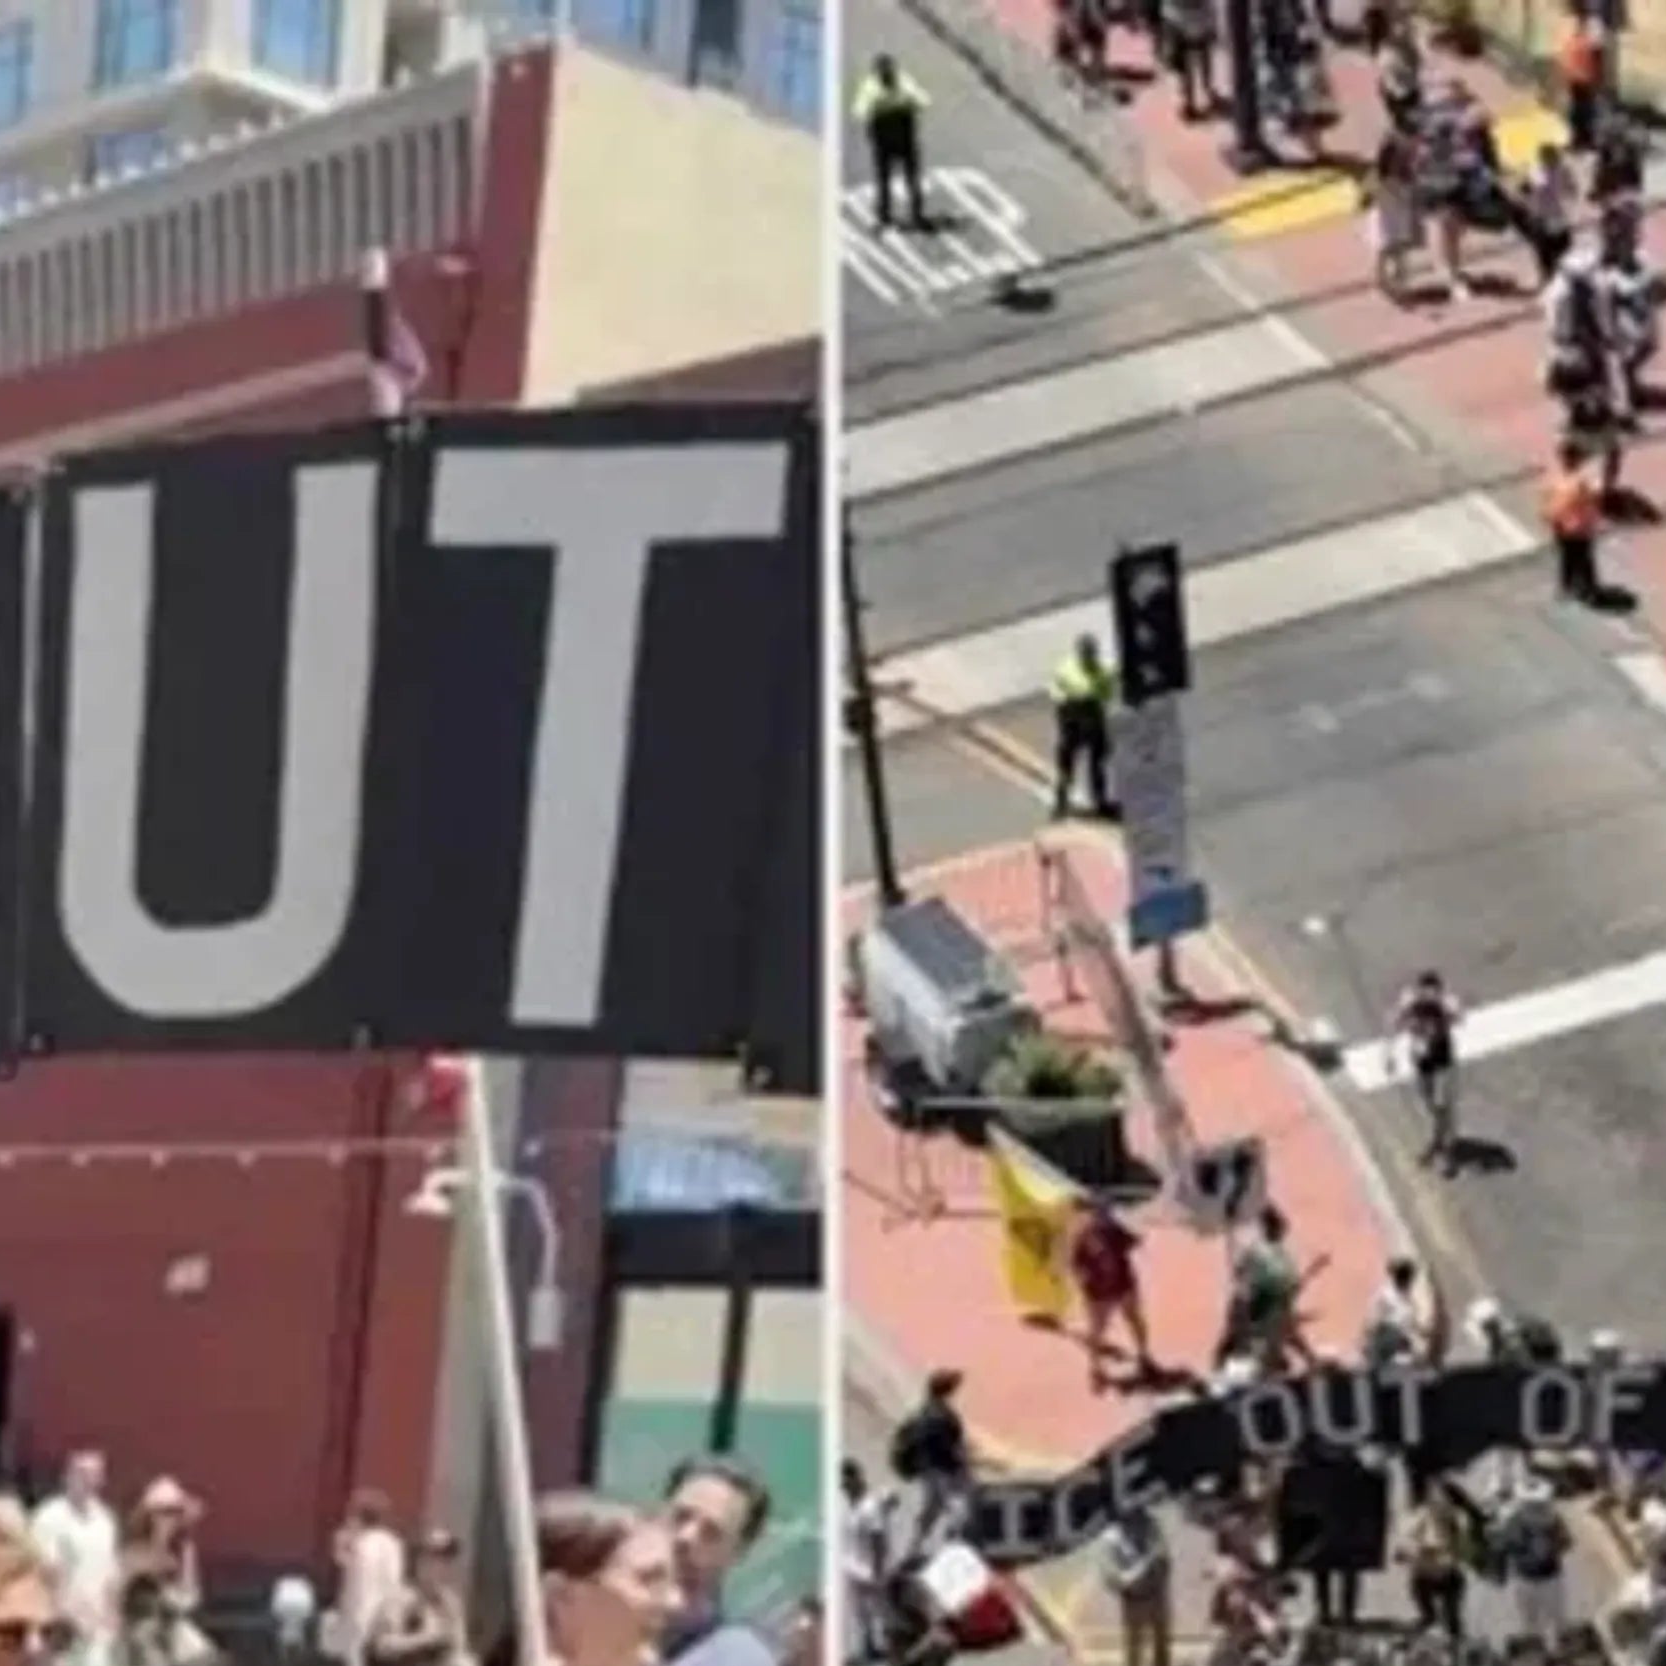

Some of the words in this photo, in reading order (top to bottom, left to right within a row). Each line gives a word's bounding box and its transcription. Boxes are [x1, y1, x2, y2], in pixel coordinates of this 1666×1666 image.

[983, 1421, 1169, 1556] ICE
[1240, 1364, 1438, 1454] OUT
[1519, 1366, 1659, 1446] OF
